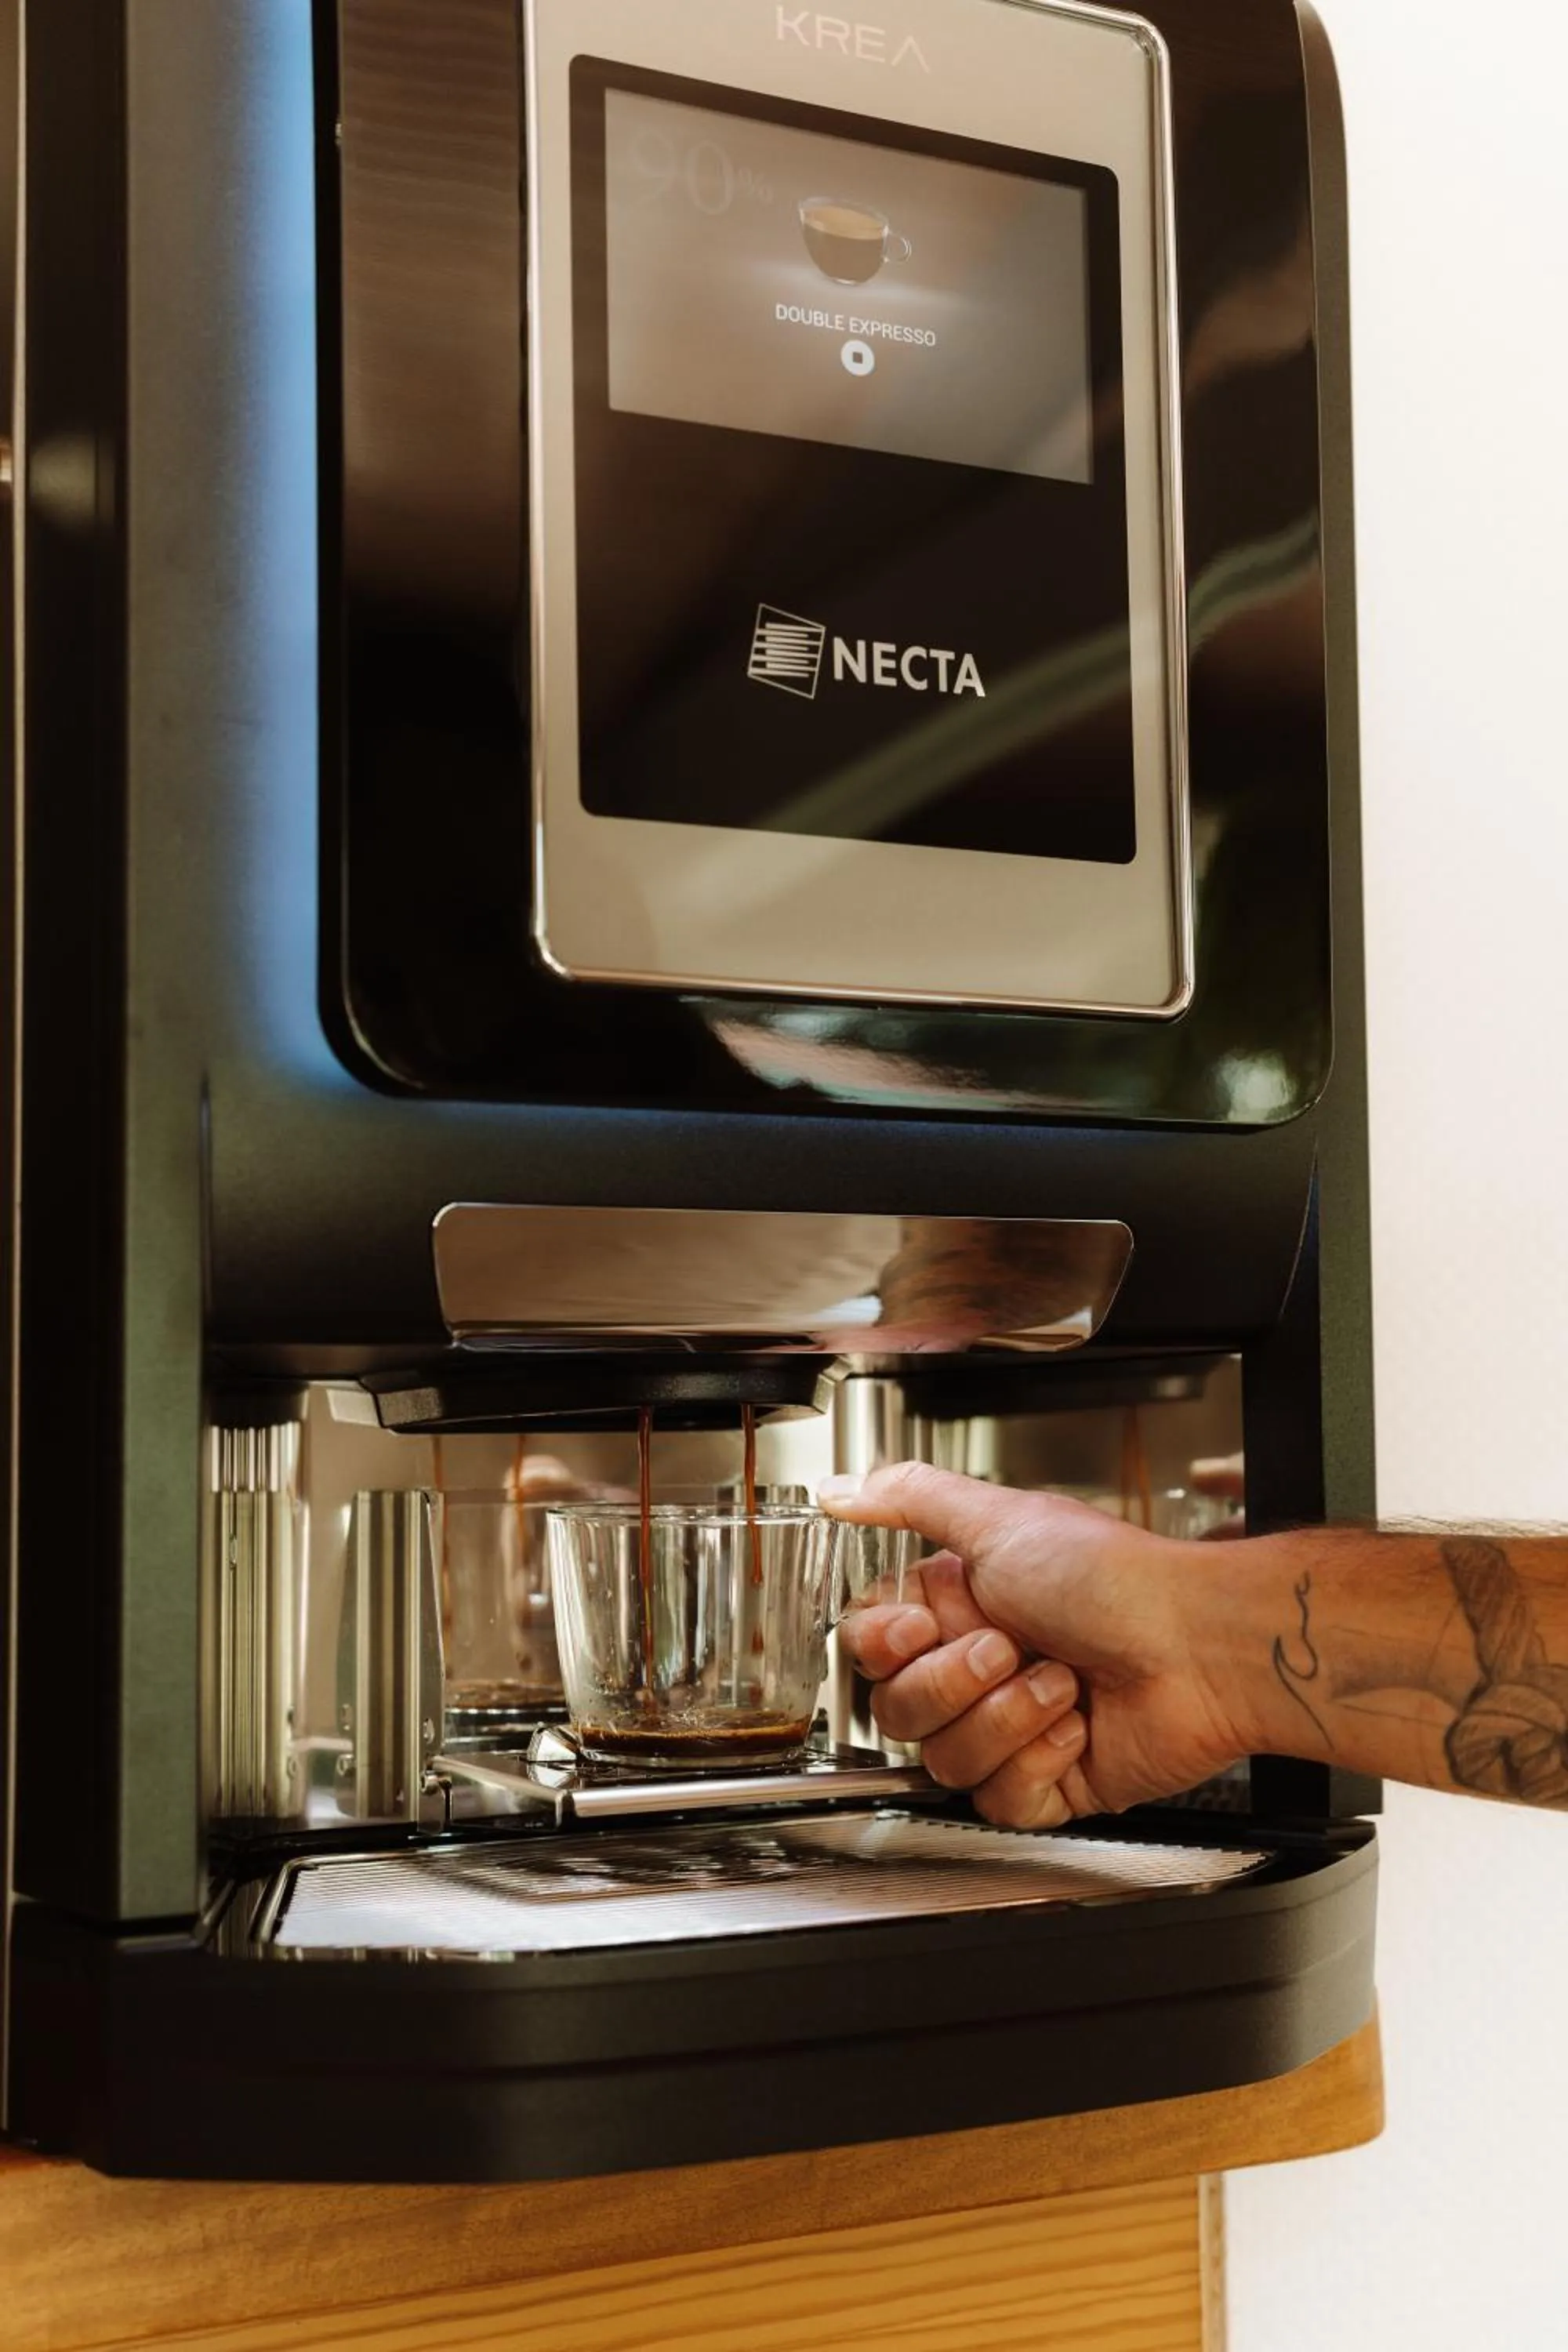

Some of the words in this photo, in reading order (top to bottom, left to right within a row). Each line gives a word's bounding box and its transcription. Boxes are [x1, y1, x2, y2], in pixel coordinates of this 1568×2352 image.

[775, 302, 845, 332] DOUBLE
[849, 316, 937, 347] EXPRESSO
[832, 636, 986, 698] NECTA
